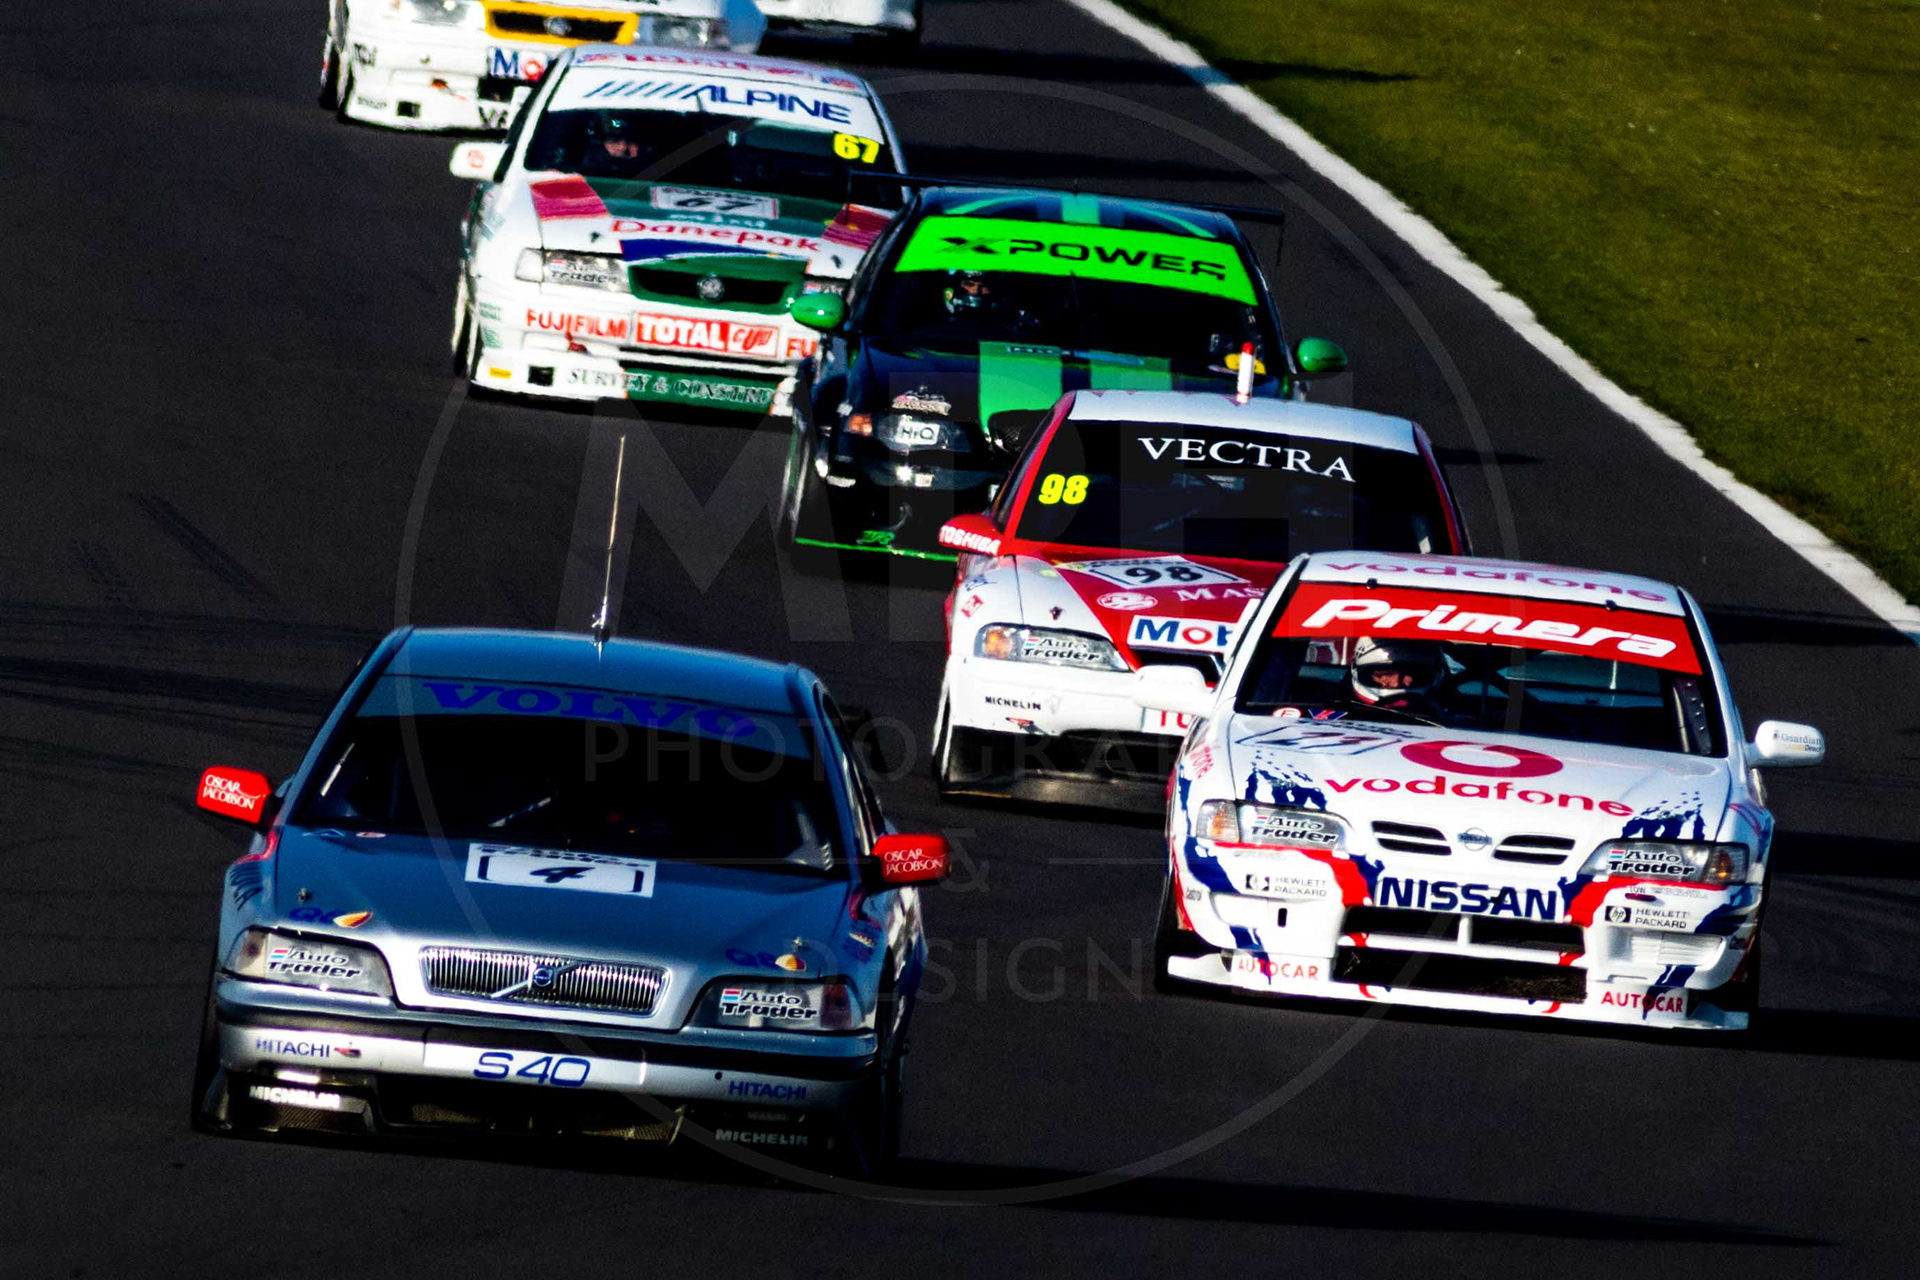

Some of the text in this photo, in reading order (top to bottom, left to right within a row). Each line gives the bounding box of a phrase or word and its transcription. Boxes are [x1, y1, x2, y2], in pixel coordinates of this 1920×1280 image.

[680, 84, 852, 125] ALPINE
[832, 132, 880, 164] 67
[611, 218, 821, 252] Danepak
[526, 307, 629, 340] FUJIFILM
[638, 313, 727, 350] TOTAL
[567, 367, 652, 393] SURVEY
[652, 376, 669, 394] &
[1137, 436, 1357, 484] VECTRA
[1037, 473, 1091, 505] 98
[938, 525, 1002, 556] TOSHIBA
[1124, 565, 1204, 584] 98
[1322, 560, 1670, 603] vodafone
[1301, 598, 1678, 659] Primera
[1038, 636, 1090, 650] Auto
[1022, 647, 1101, 662] Trader
[423, 681, 757, 738] VOLVO
[985, 695, 1042, 711] MICHELIN
[205, 774, 242, 794] OSCAR
[202, 786, 257, 810] JACOBSON
[1323, 776, 1634, 817] vodafone
[1268, 816, 1322, 830] Auto
[1251, 825, 1337, 843] Trader
[884, 847, 923, 862] OSCAR
[1625, 851, 1682, 863] Auto
[529, 866, 596, 884] 4
[885, 858, 944, 875] JACOBSON
[1608, 860, 1696, 875] Trader
[1274, 876, 1327, 888] HEWLETT
[1274, 886, 1327, 898] PACKARD
[1378, 876, 1558, 921] NISSAN
[1634, 917, 1688, 929] PACKARD
[1635, 907, 1688, 919] HEWLETT
[288, 948, 349, 966] Auto
[266, 960, 361, 979] Trader
[1237, 957, 1319, 980] AUTOCAR
[739, 991, 802, 1006] Auto
[1600, 990, 1684, 1014] AUTOCAR
[719, 1001, 818, 1020] Trader
[255, 1039, 331, 1058] HITACHI
[249, 1085, 341, 1109] MICHELIN
[728, 1079, 808, 1100] HITACHI
[714, 1127, 809, 1147] MICHELIN
